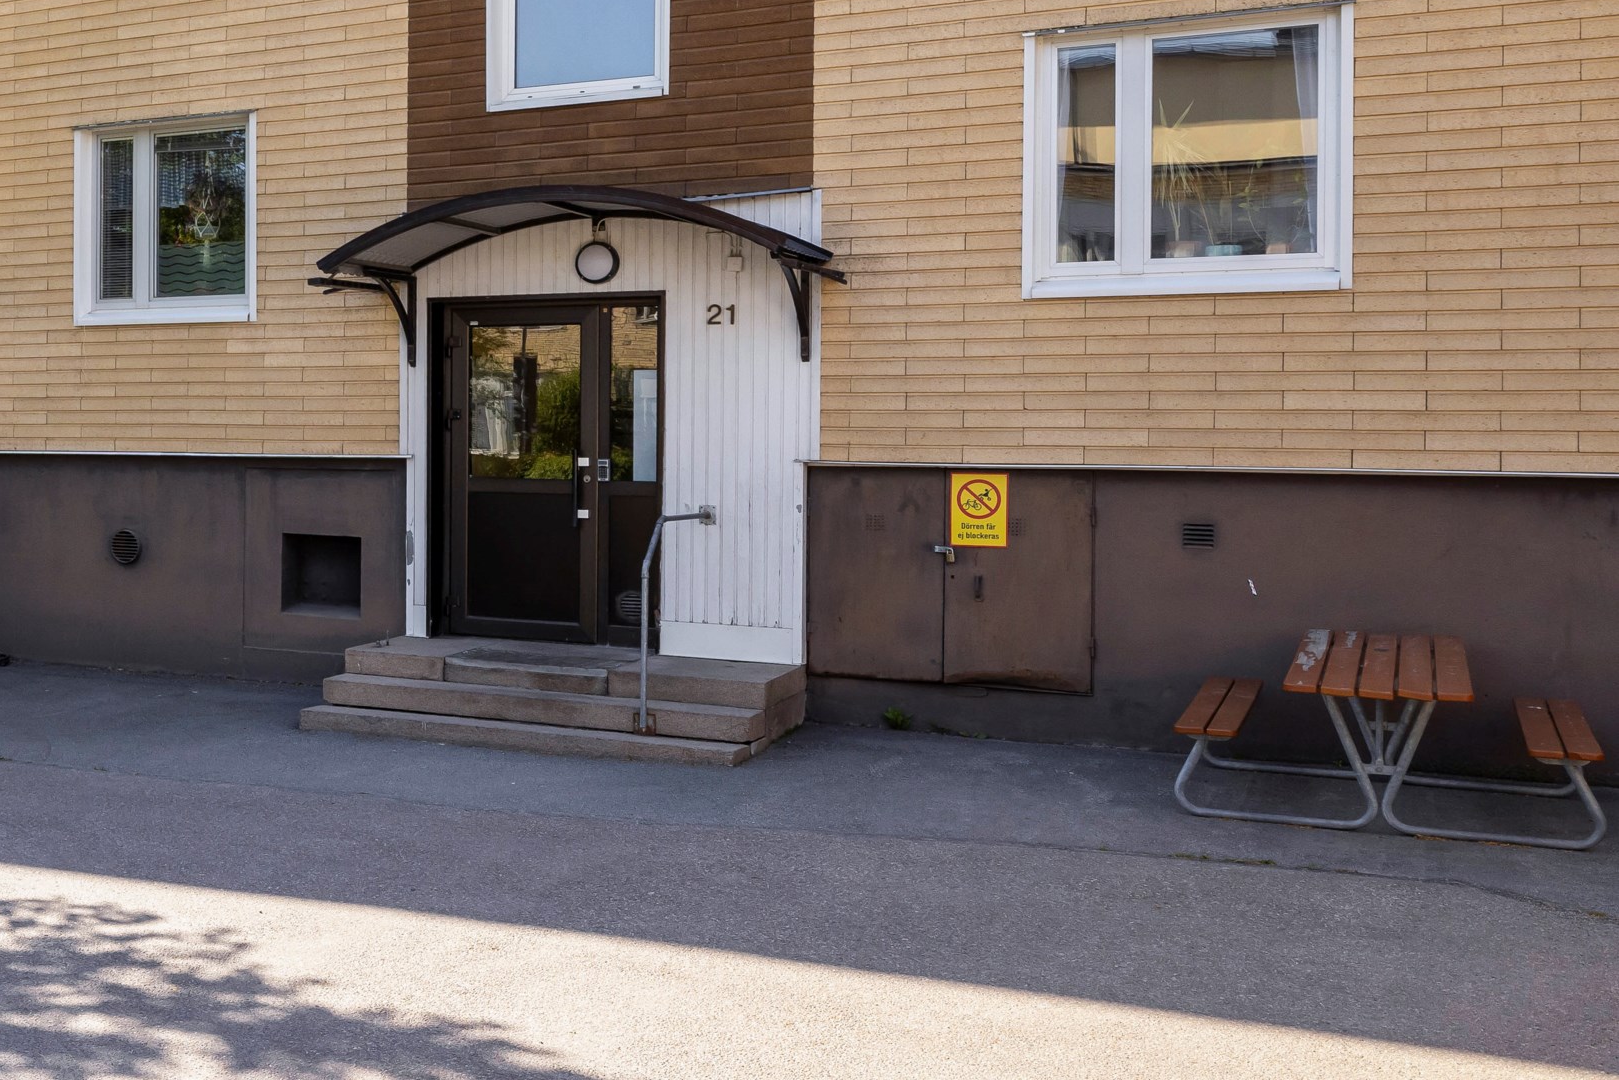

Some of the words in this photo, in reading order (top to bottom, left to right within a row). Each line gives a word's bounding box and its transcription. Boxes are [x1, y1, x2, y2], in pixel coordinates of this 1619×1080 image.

[707, 304, 735, 325] 21
[961, 522, 984, 530] Dörren
[986, 522, 996, 530] får
[965, 532, 999, 540] blockeras
